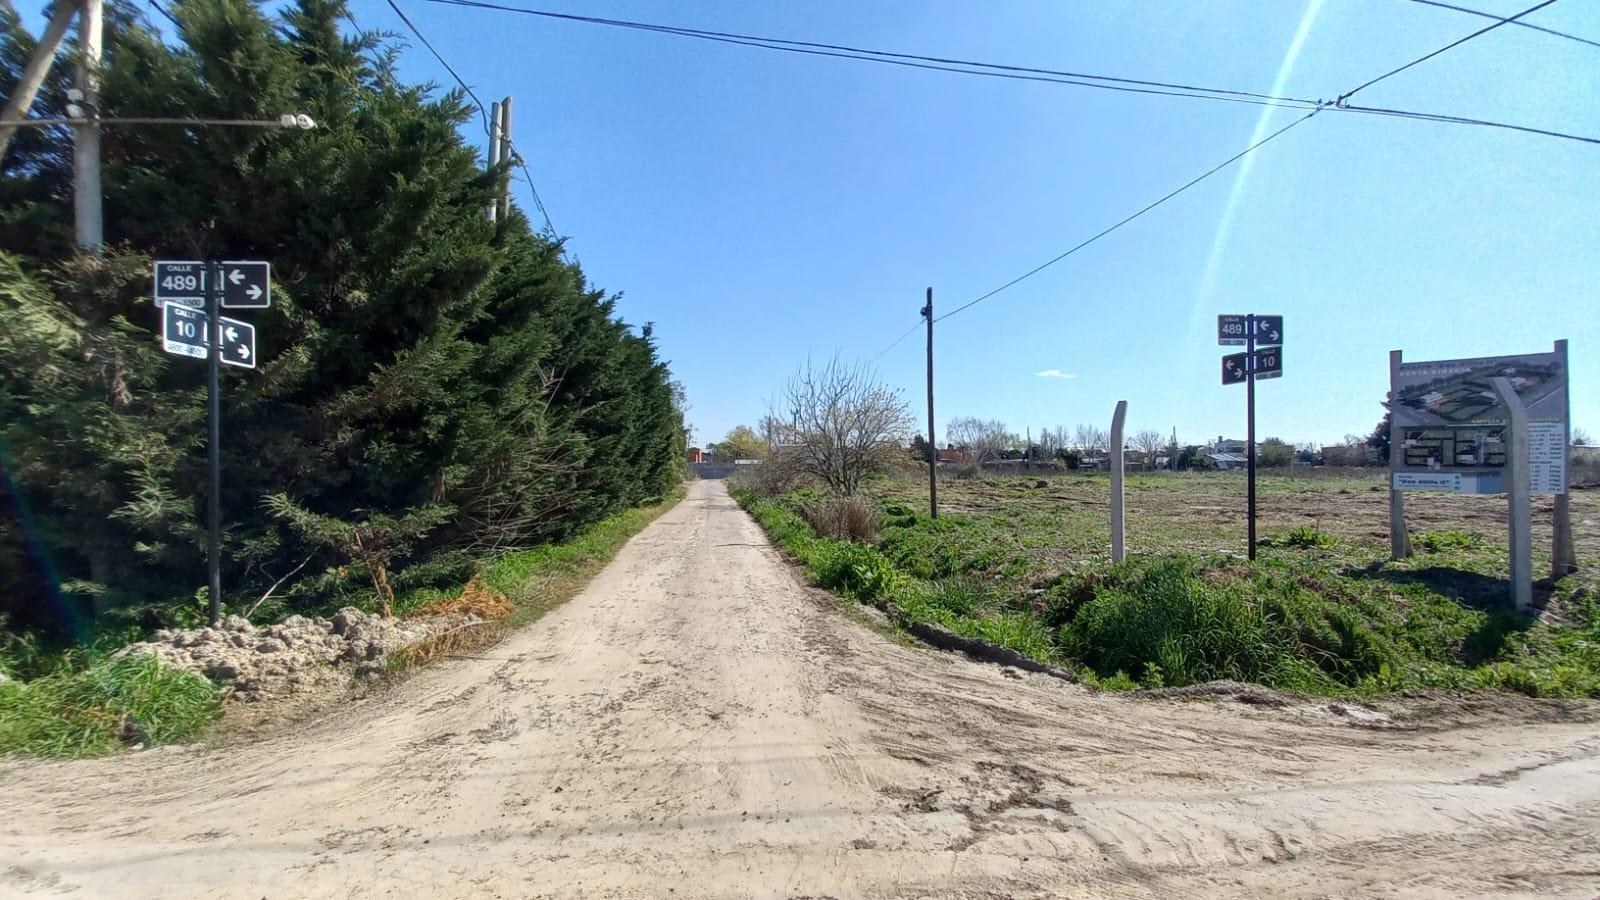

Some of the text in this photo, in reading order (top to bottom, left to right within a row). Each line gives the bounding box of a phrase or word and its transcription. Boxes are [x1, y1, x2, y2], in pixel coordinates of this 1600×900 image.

[162, 276, 197, 291] 489
[175, 308, 196, 319] CALLE
[175, 320, 196, 338] 10
[1223, 324, 1242, 334] 489
[1262, 356, 1275, 368] 10
